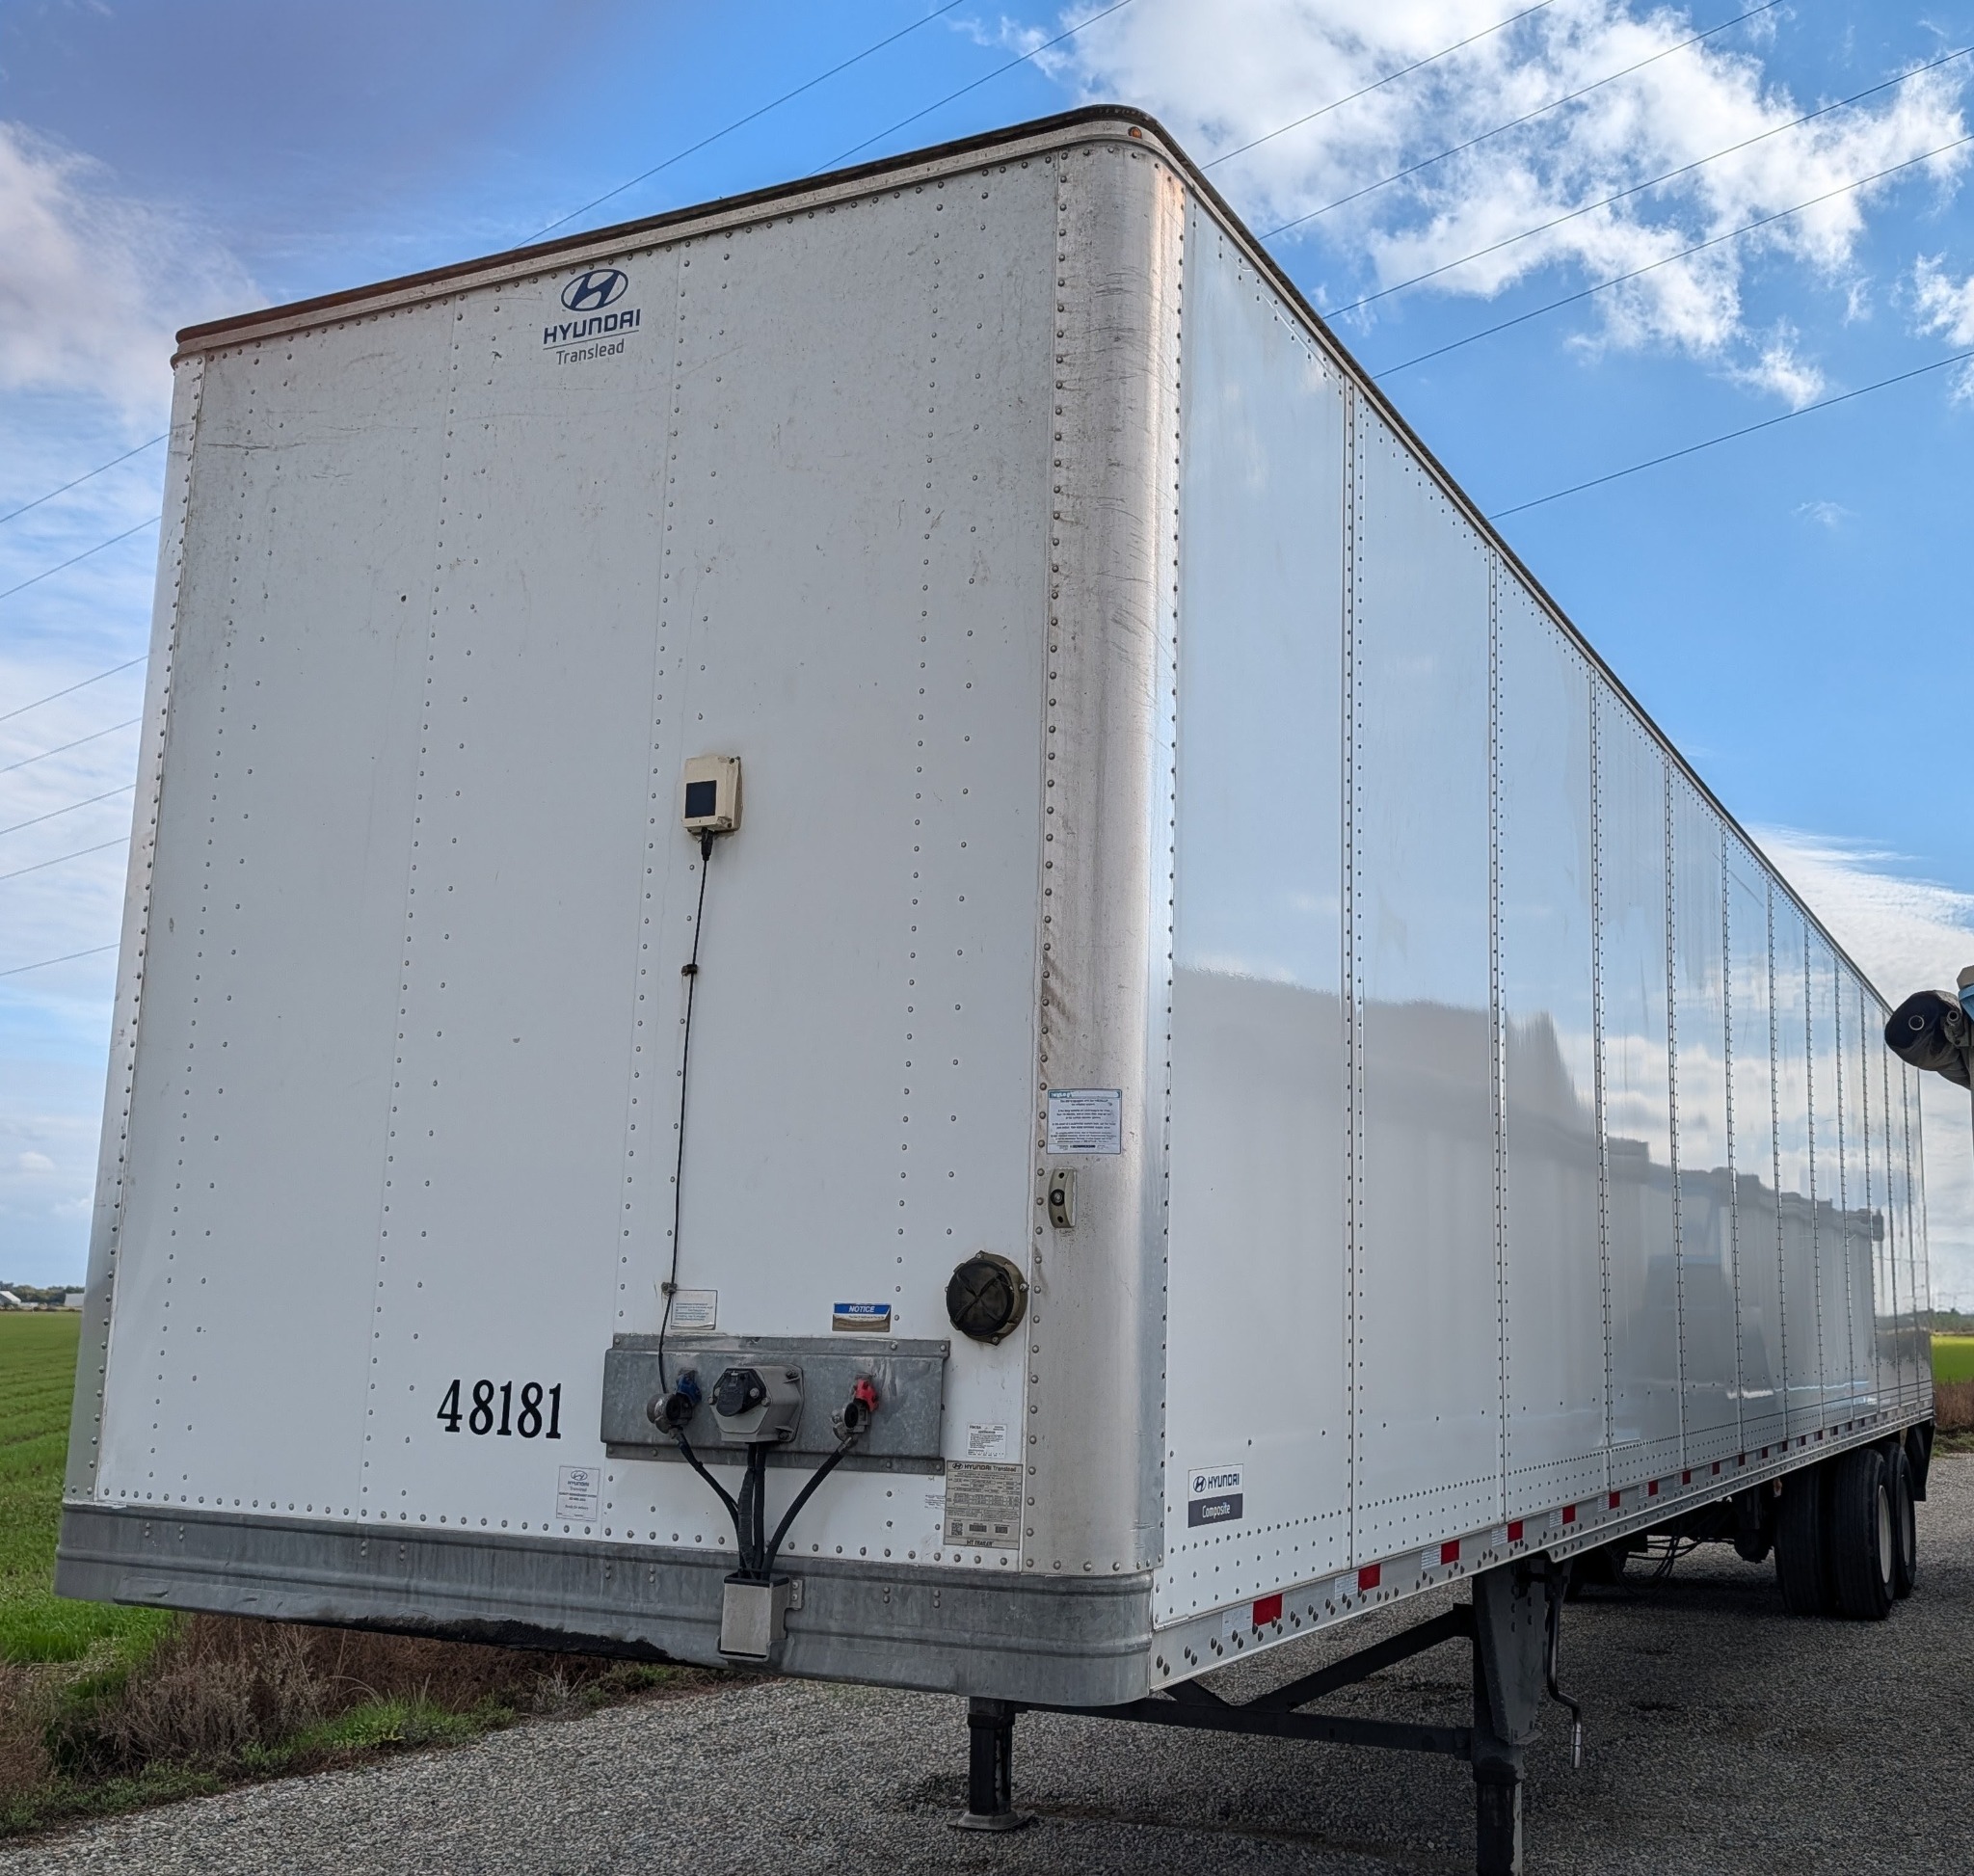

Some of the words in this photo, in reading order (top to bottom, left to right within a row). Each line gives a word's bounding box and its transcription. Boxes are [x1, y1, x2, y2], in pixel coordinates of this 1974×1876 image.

[544, 308, 641, 344] HYUNDAI
[556, 337, 625, 365] Translead
[437, 1379, 562, 1439] 48181
[1208, 1473, 1240, 1489] HYUNDAI
[1202, 1502, 1231, 1519] Composite
